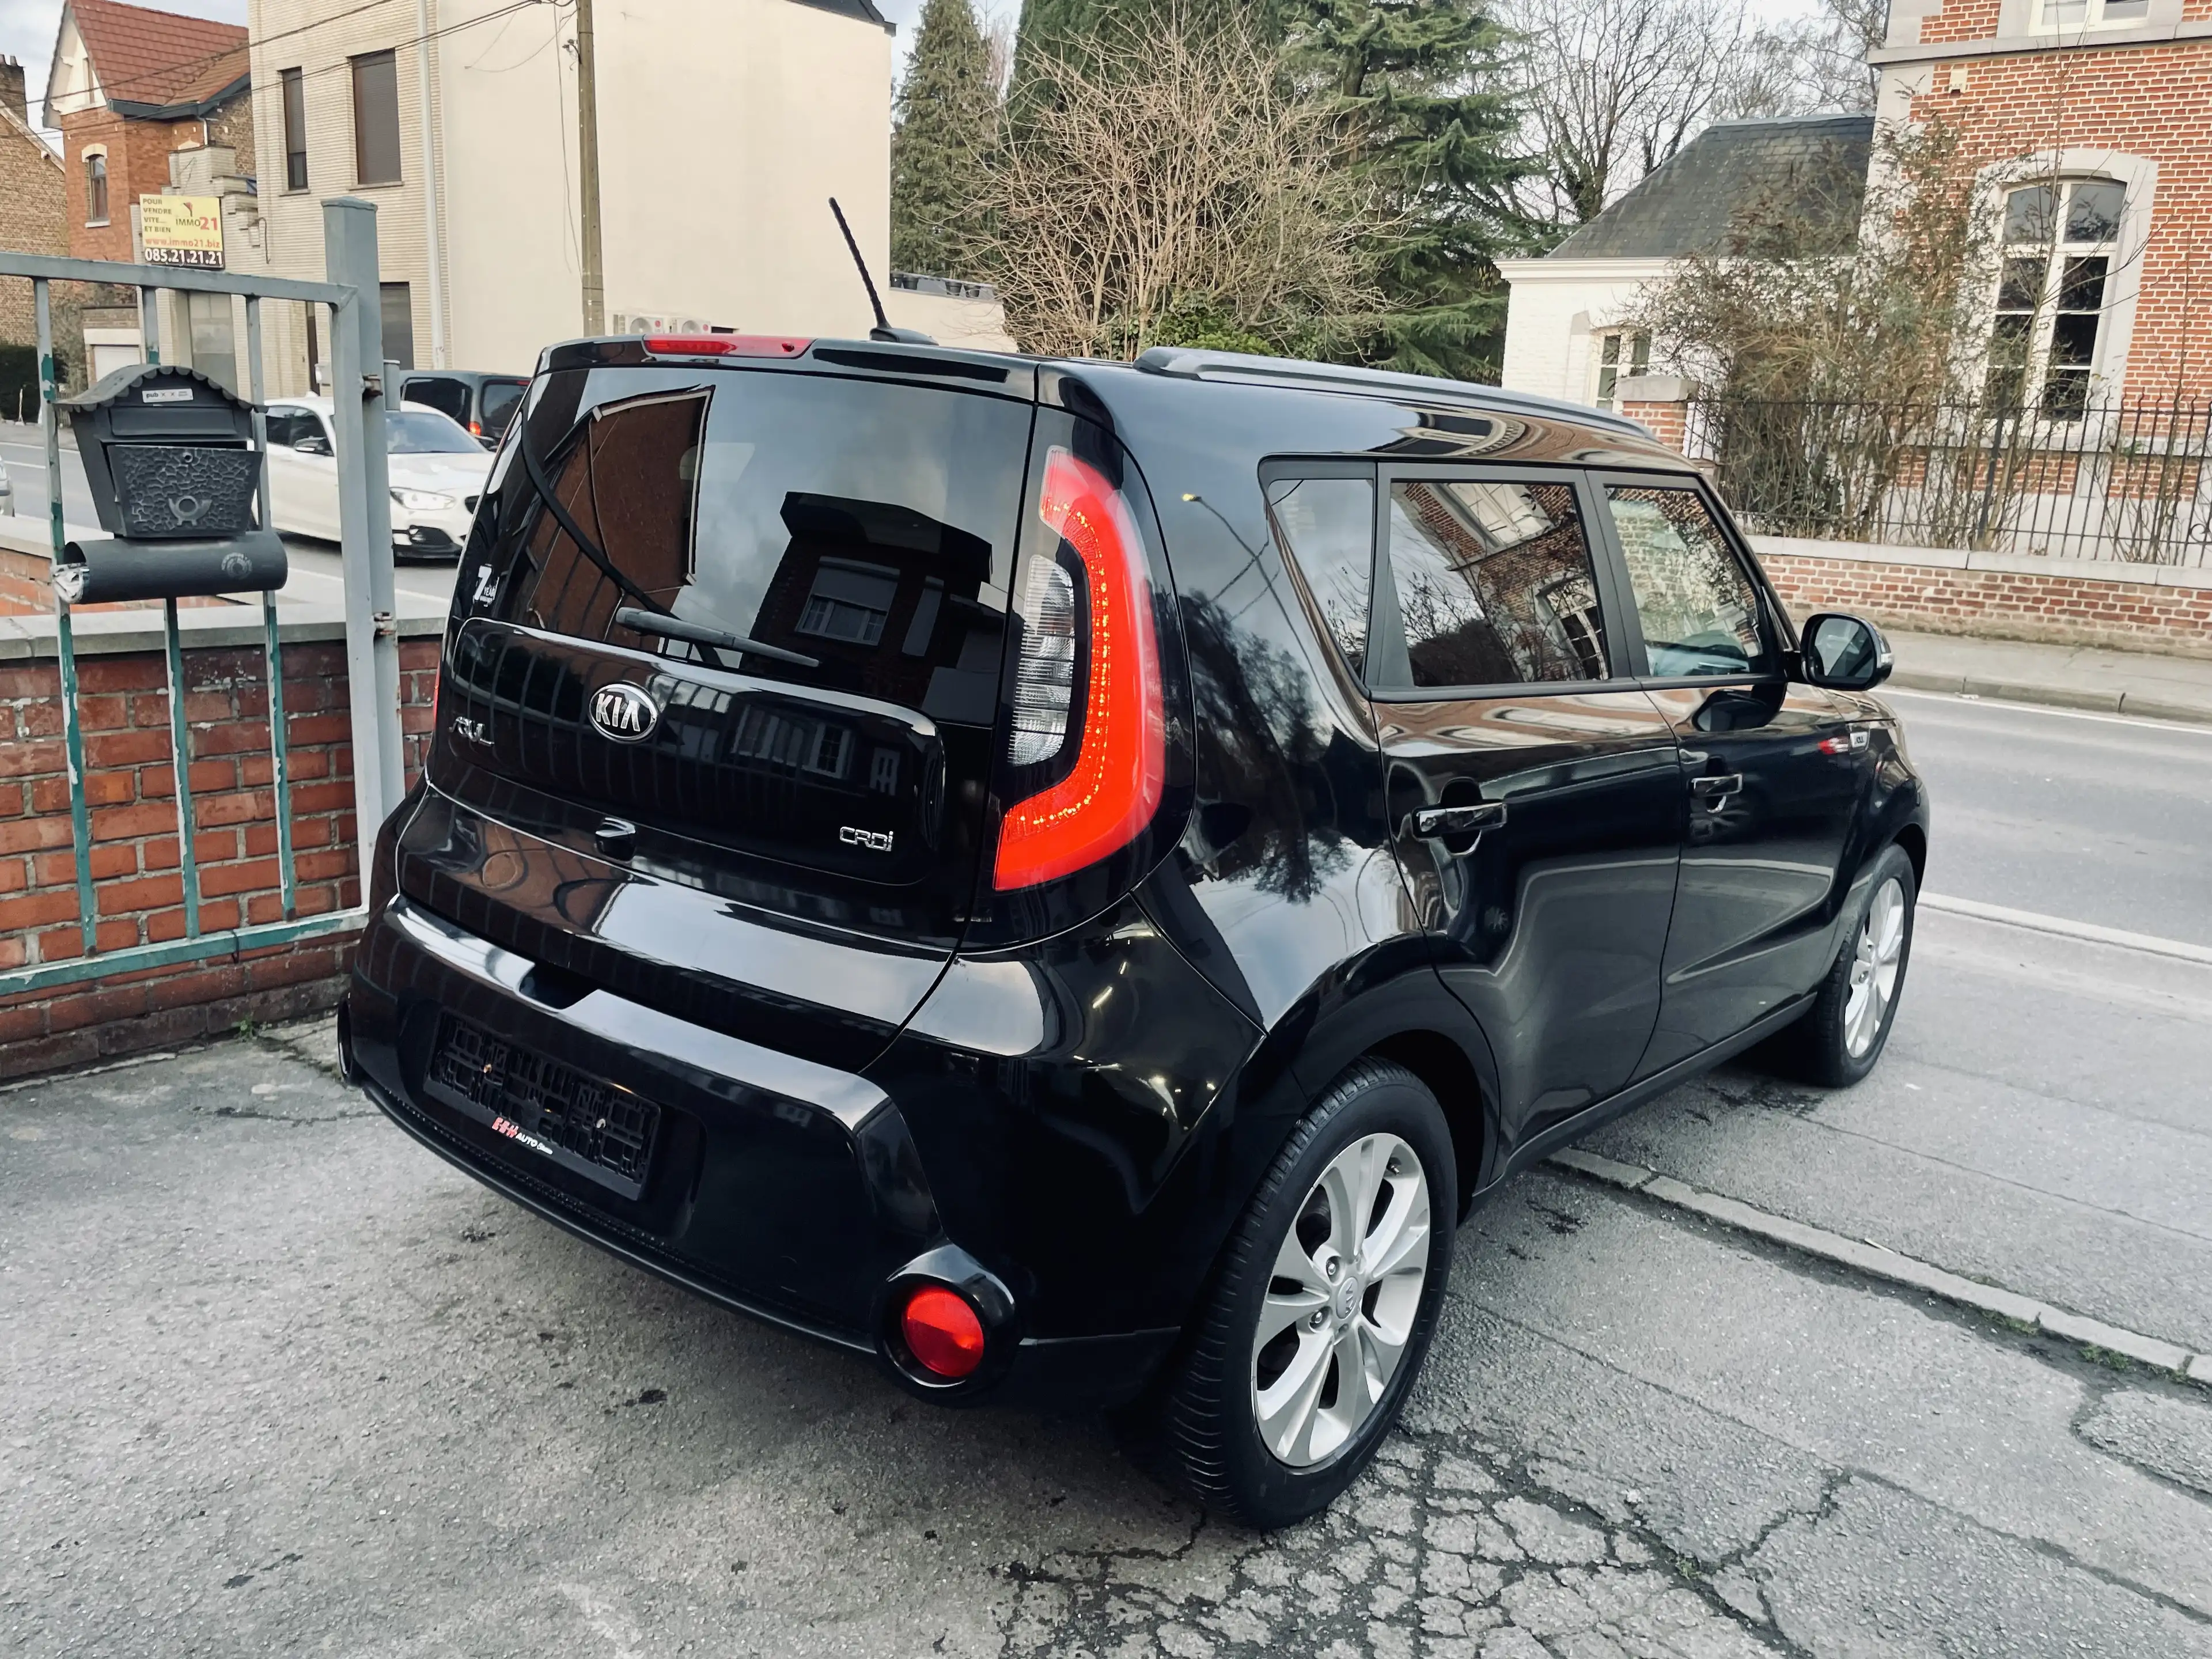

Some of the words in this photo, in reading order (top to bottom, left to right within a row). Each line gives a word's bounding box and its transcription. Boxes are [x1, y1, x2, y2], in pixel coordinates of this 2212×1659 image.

[146, 238, 220, 248] www.immo21.biz
[145, 248, 222, 265] 085.21.21.21
[596, 693, 641, 732] KIA
[515, 1132, 538, 1147] AUTO
